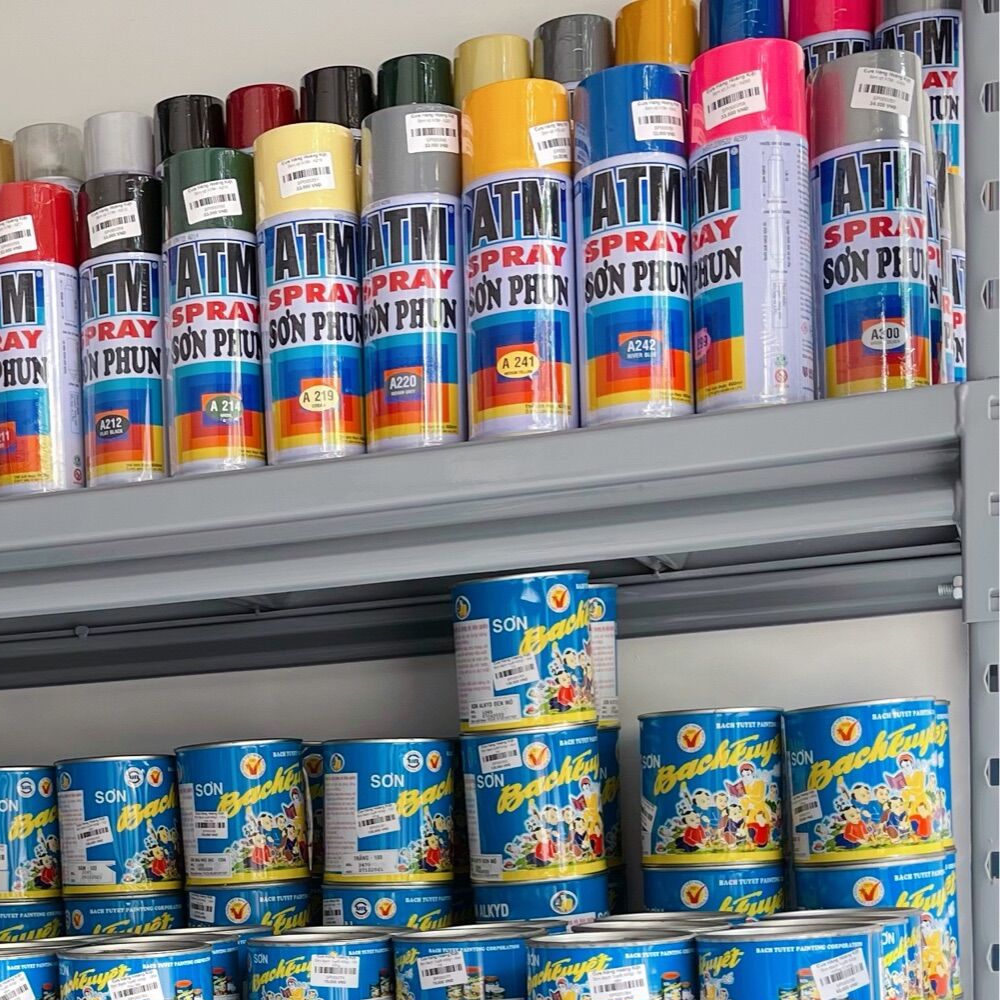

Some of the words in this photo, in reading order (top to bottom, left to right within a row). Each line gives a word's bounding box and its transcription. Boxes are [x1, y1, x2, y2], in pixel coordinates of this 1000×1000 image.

[591, 165, 682, 232] ATM
[832, 150, 923, 218] ATM
[472, 178, 561, 247] ATM
[367, 205, 447, 270] ATM
[585, 231, 686, 263] SPRAY
[824, 215, 926, 249] SPRAY
[274, 221, 357, 281] ATM
[468, 244, 566, 278] SPRAY
[177, 242, 257, 298] ATM
[585, 260, 626, 303] SƠN
[632, 260, 689, 295] PHUN
[823, 246, 868, 290] SƠN
[82, 262, 150, 319] ATM
[269, 283, 360, 310] SPRAY
[363, 269, 453, 300] SPRAY
[468, 275, 502, 316] SƠN
[508, 274, 568, 307] PHUN
[172, 301, 260, 328] SPRAY
[269, 309, 307, 348] SƠN
[312, 310, 363, 342] PHUN
[395, 298, 456, 330] PHUN
[173, 326, 207, 364] SƠN
[213, 328, 262, 360] PHUN
[627, 339, 656, 352] A242
[870, 326, 900, 341] A300
[104, 347, 161, 376] PHUN
[502, 357, 509, 369] A
[514, 355, 535, 368] 241
[303, 391, 311, 403] A
[315, 389, 334, 402] 219
[389, 375, 416, 389] A220
[100, 418, 122, 431] A212
[492, 615, 528, 633] SƠN
[791, 749, 815, 766] SƠN
[195, 781, 223, 797] SƠN
[370, 772, 404, 788] SƠN
[477, 772, 504, 789] SƠN
[95, 789, 126, 804] SƠN
